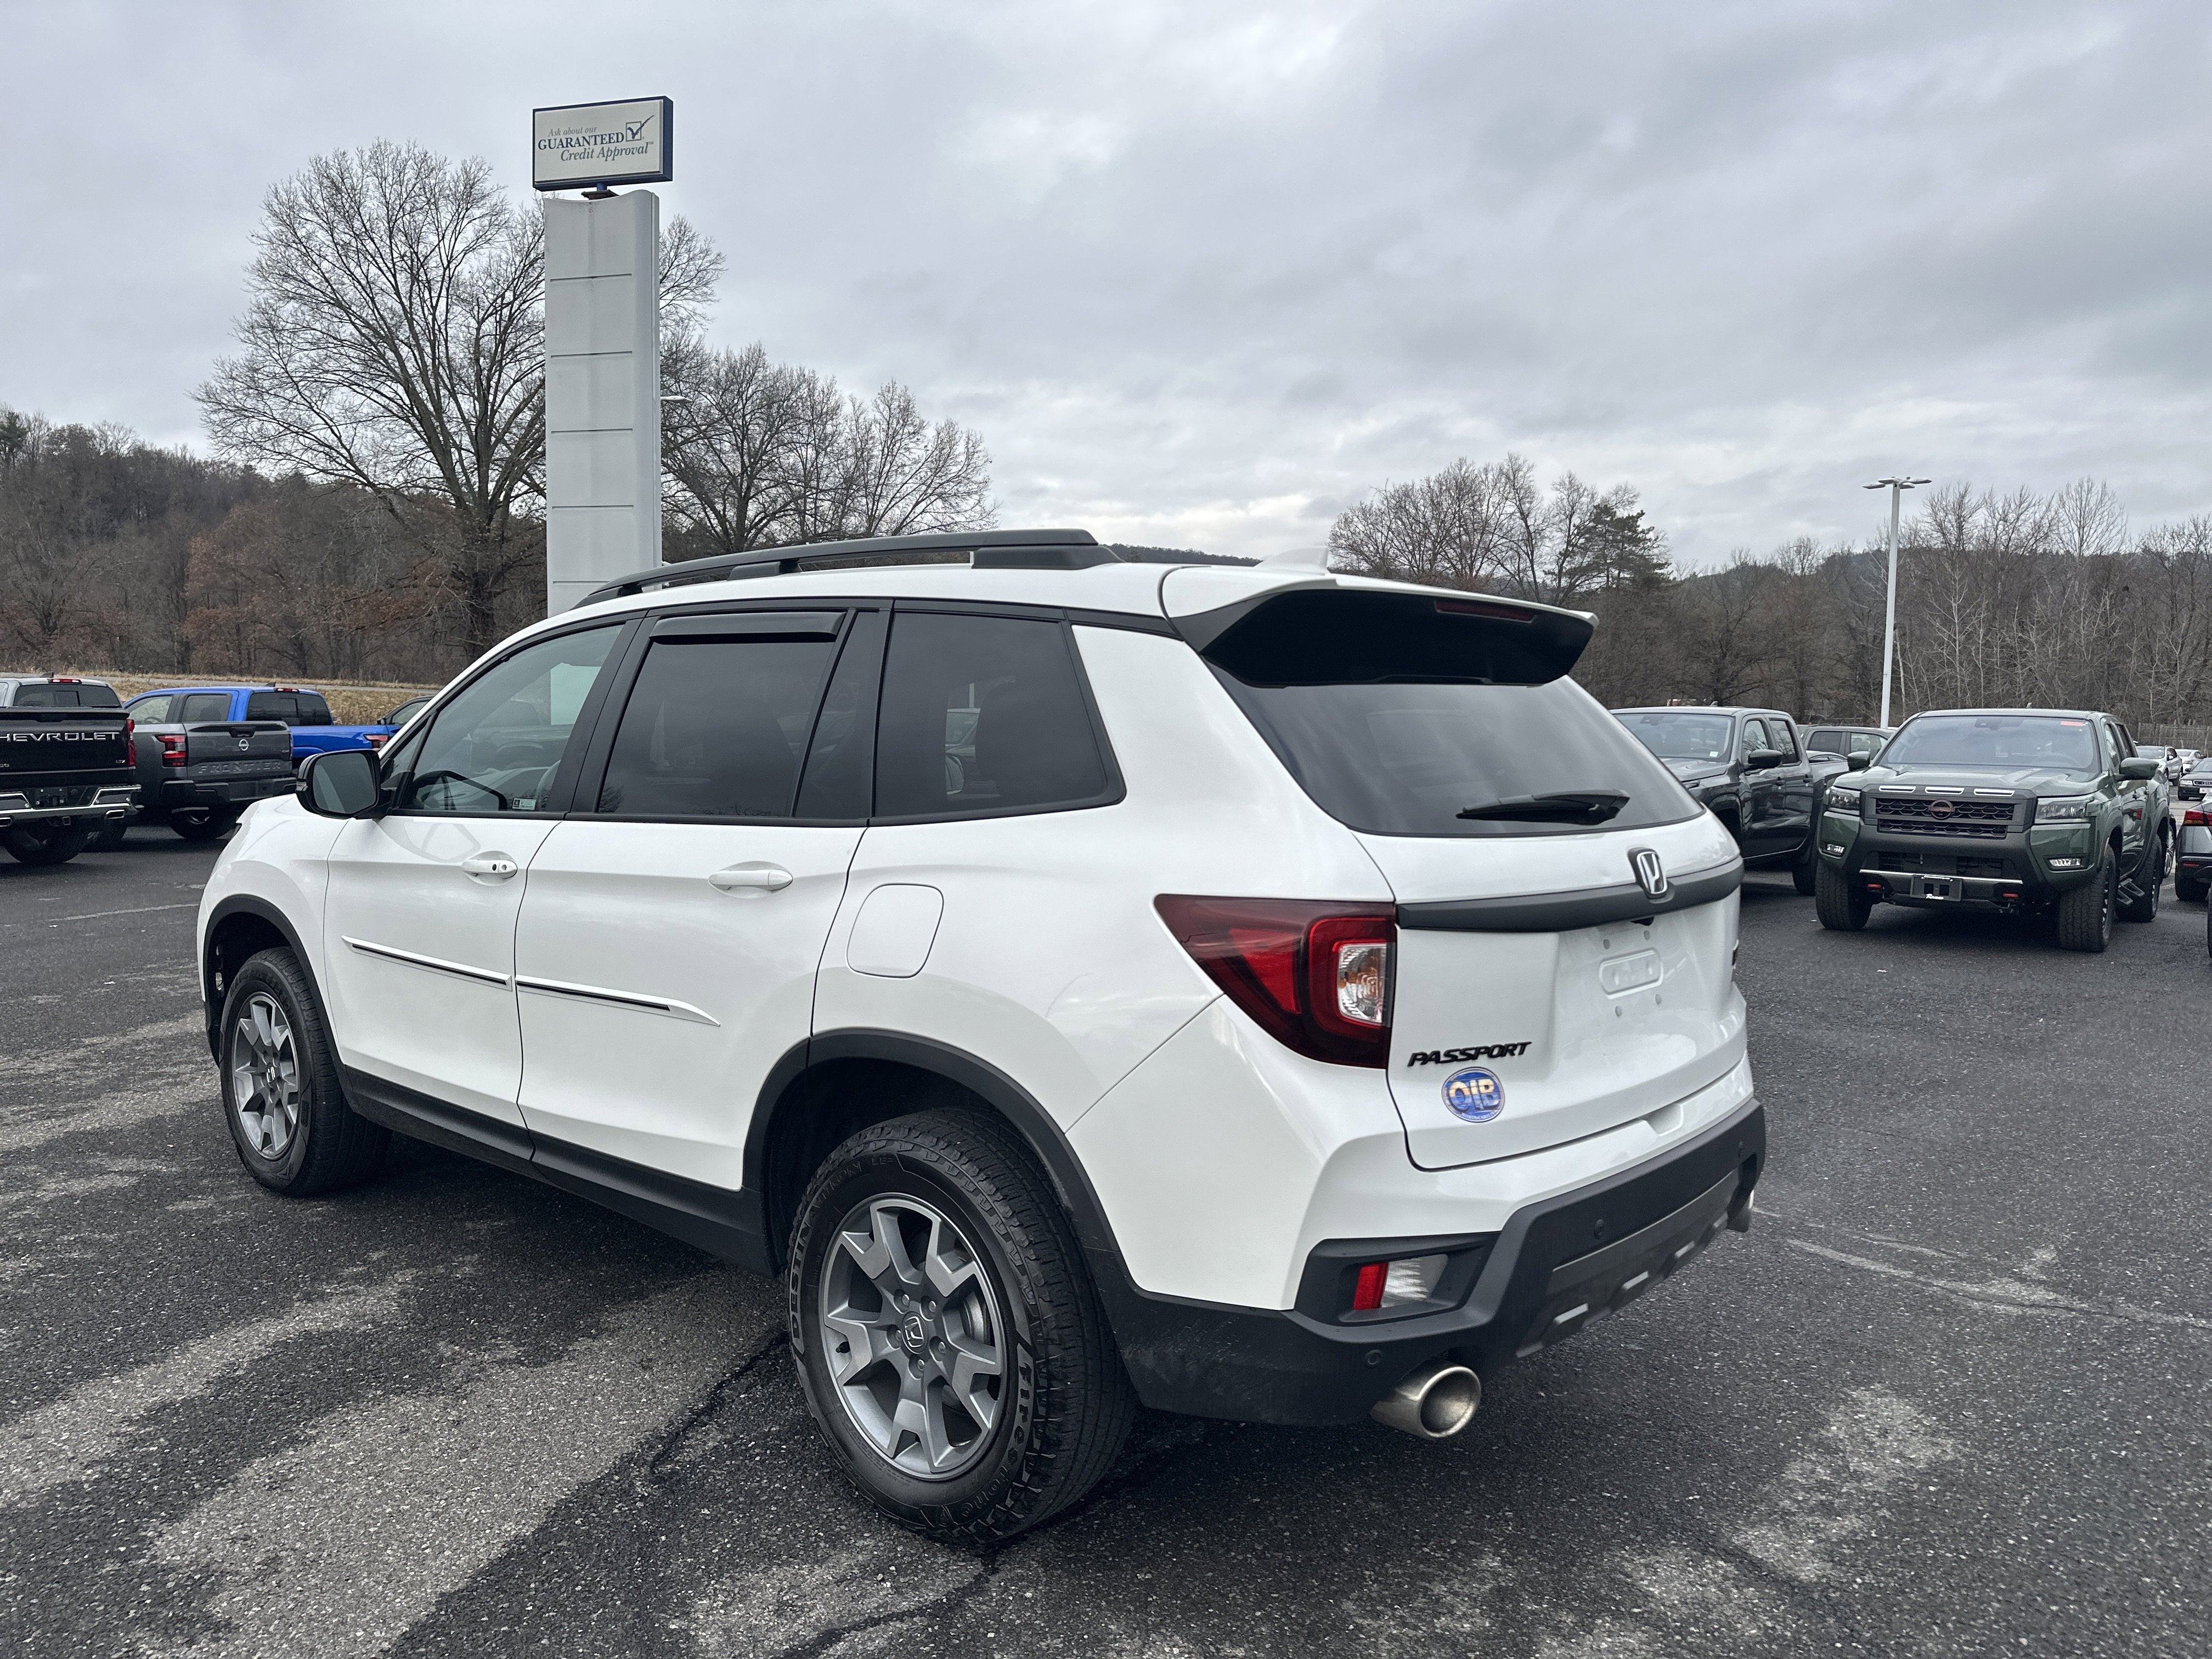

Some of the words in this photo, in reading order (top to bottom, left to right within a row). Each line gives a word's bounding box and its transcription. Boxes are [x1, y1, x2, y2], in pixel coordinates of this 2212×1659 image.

[538, 132, 624, 150] GUARANTEED
[548, 128, 561, 137] Ask
[563, 127, 583, 136] about
[561, 148, 594, 161] Credit
[596, 142, 649, 162] Approval
[198, 761, 281, 774] FRONTIER
[1407, 1041, 1532, 1067] PASSPORT
[1448, 1078, 1500, 1112] OIB
